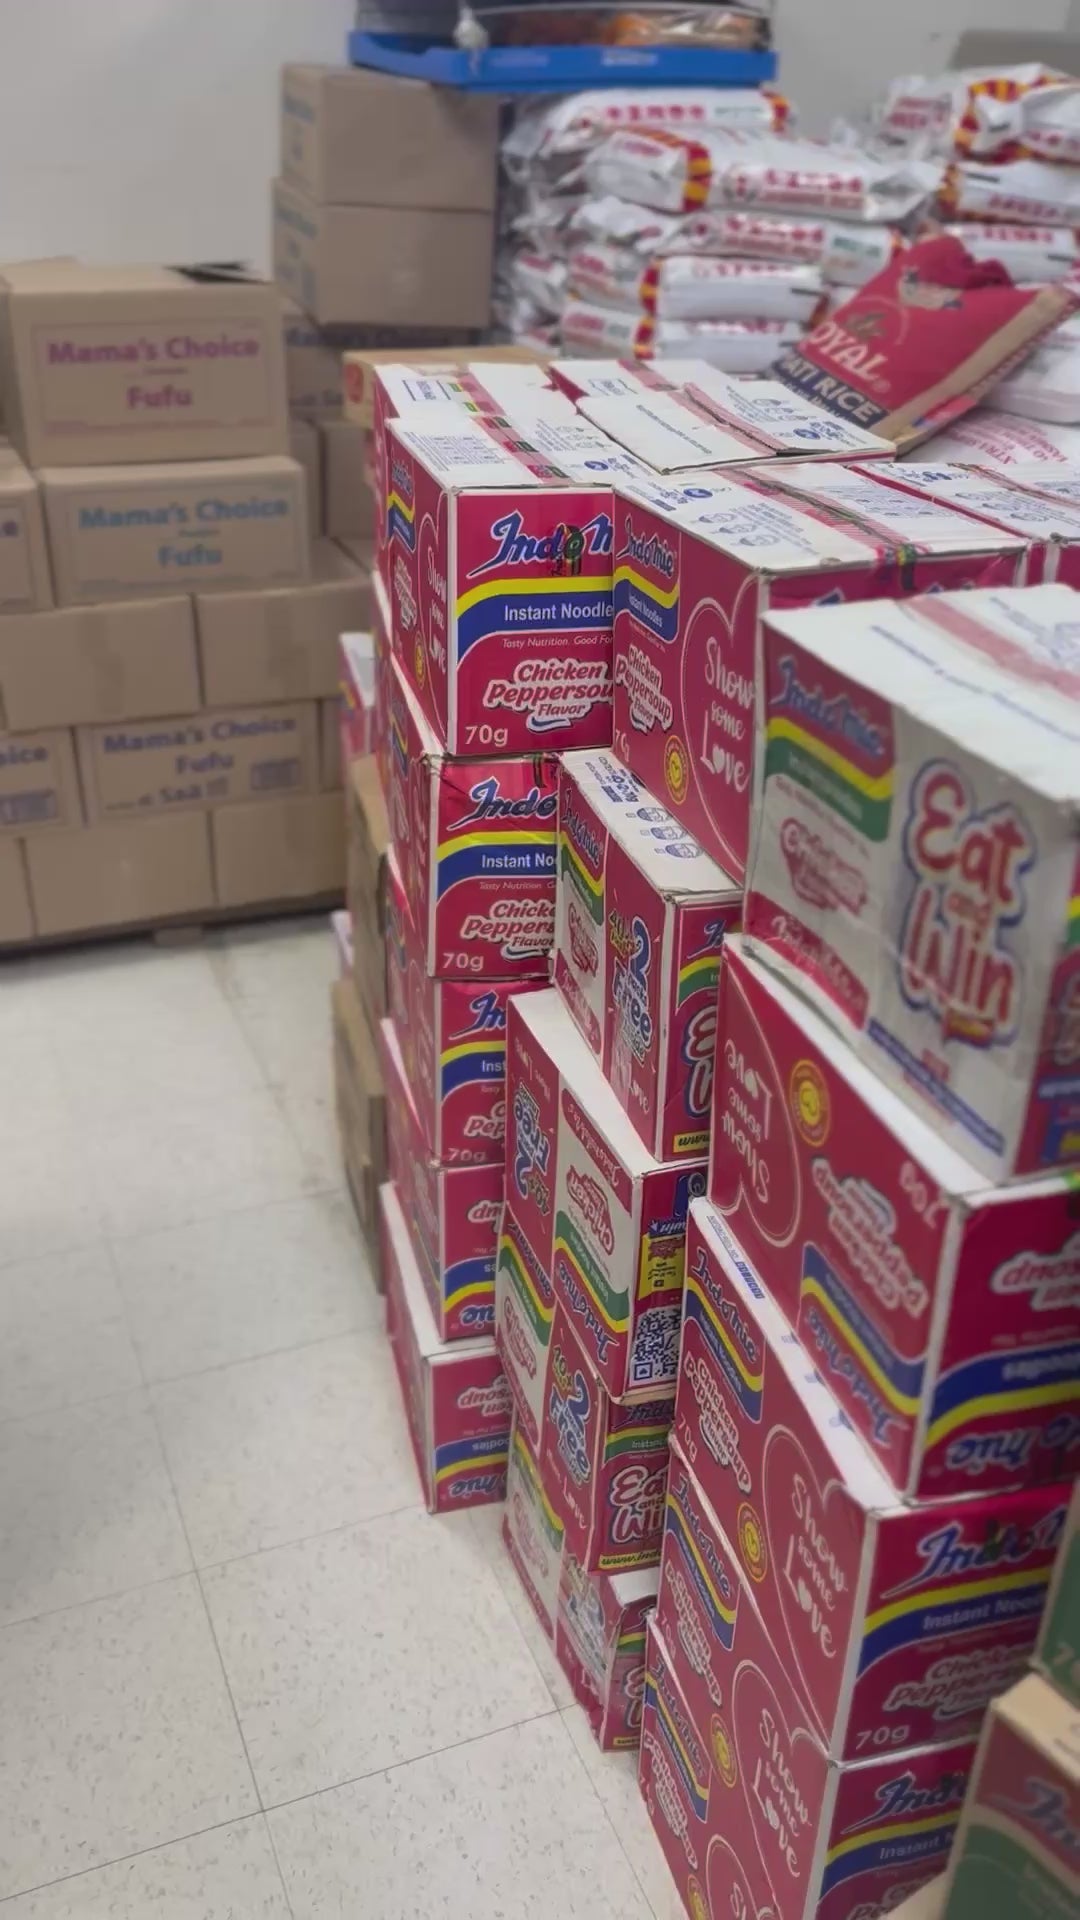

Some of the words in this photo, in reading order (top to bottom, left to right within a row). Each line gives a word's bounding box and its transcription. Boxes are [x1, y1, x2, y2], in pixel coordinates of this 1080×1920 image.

[46, 338, 159, 365] Mama's
[165, 331, 260, 361] Choice
[126, 385, 193, 410] Fufu
[811, 376, 882, 422] RICE
[79, 504, 188, 530] Mama's
[196, 497, 289, 522] Choice
[157, 545, 223, 568] Fufu
[504, 603, 557, 622] Instant
[561, 601, 613, 620] Noodle
[503, 637, 525, 650] Tasty
[573, 633, 601, 645] Good
[516, 661, 603, 685] Chicken
[704, 636, 757, 709] Show
[488, 683, 613, 709] Peppersou
[538, 702, 586, 718] Flavor
[711, 700, 746, 742] some
[465, 727, 509, 748] 70g
[446, 776, 557, 831] Indo
[482, 854, 530, 868] Instant
[493, 903, 556, 918] Chick
[443, 953, 484, 971] 70g
[792, 1473, 848, 1592] Show
[924, 1602, 990, 1631] Instant
[855, 1724, 911, 1751] 70g
